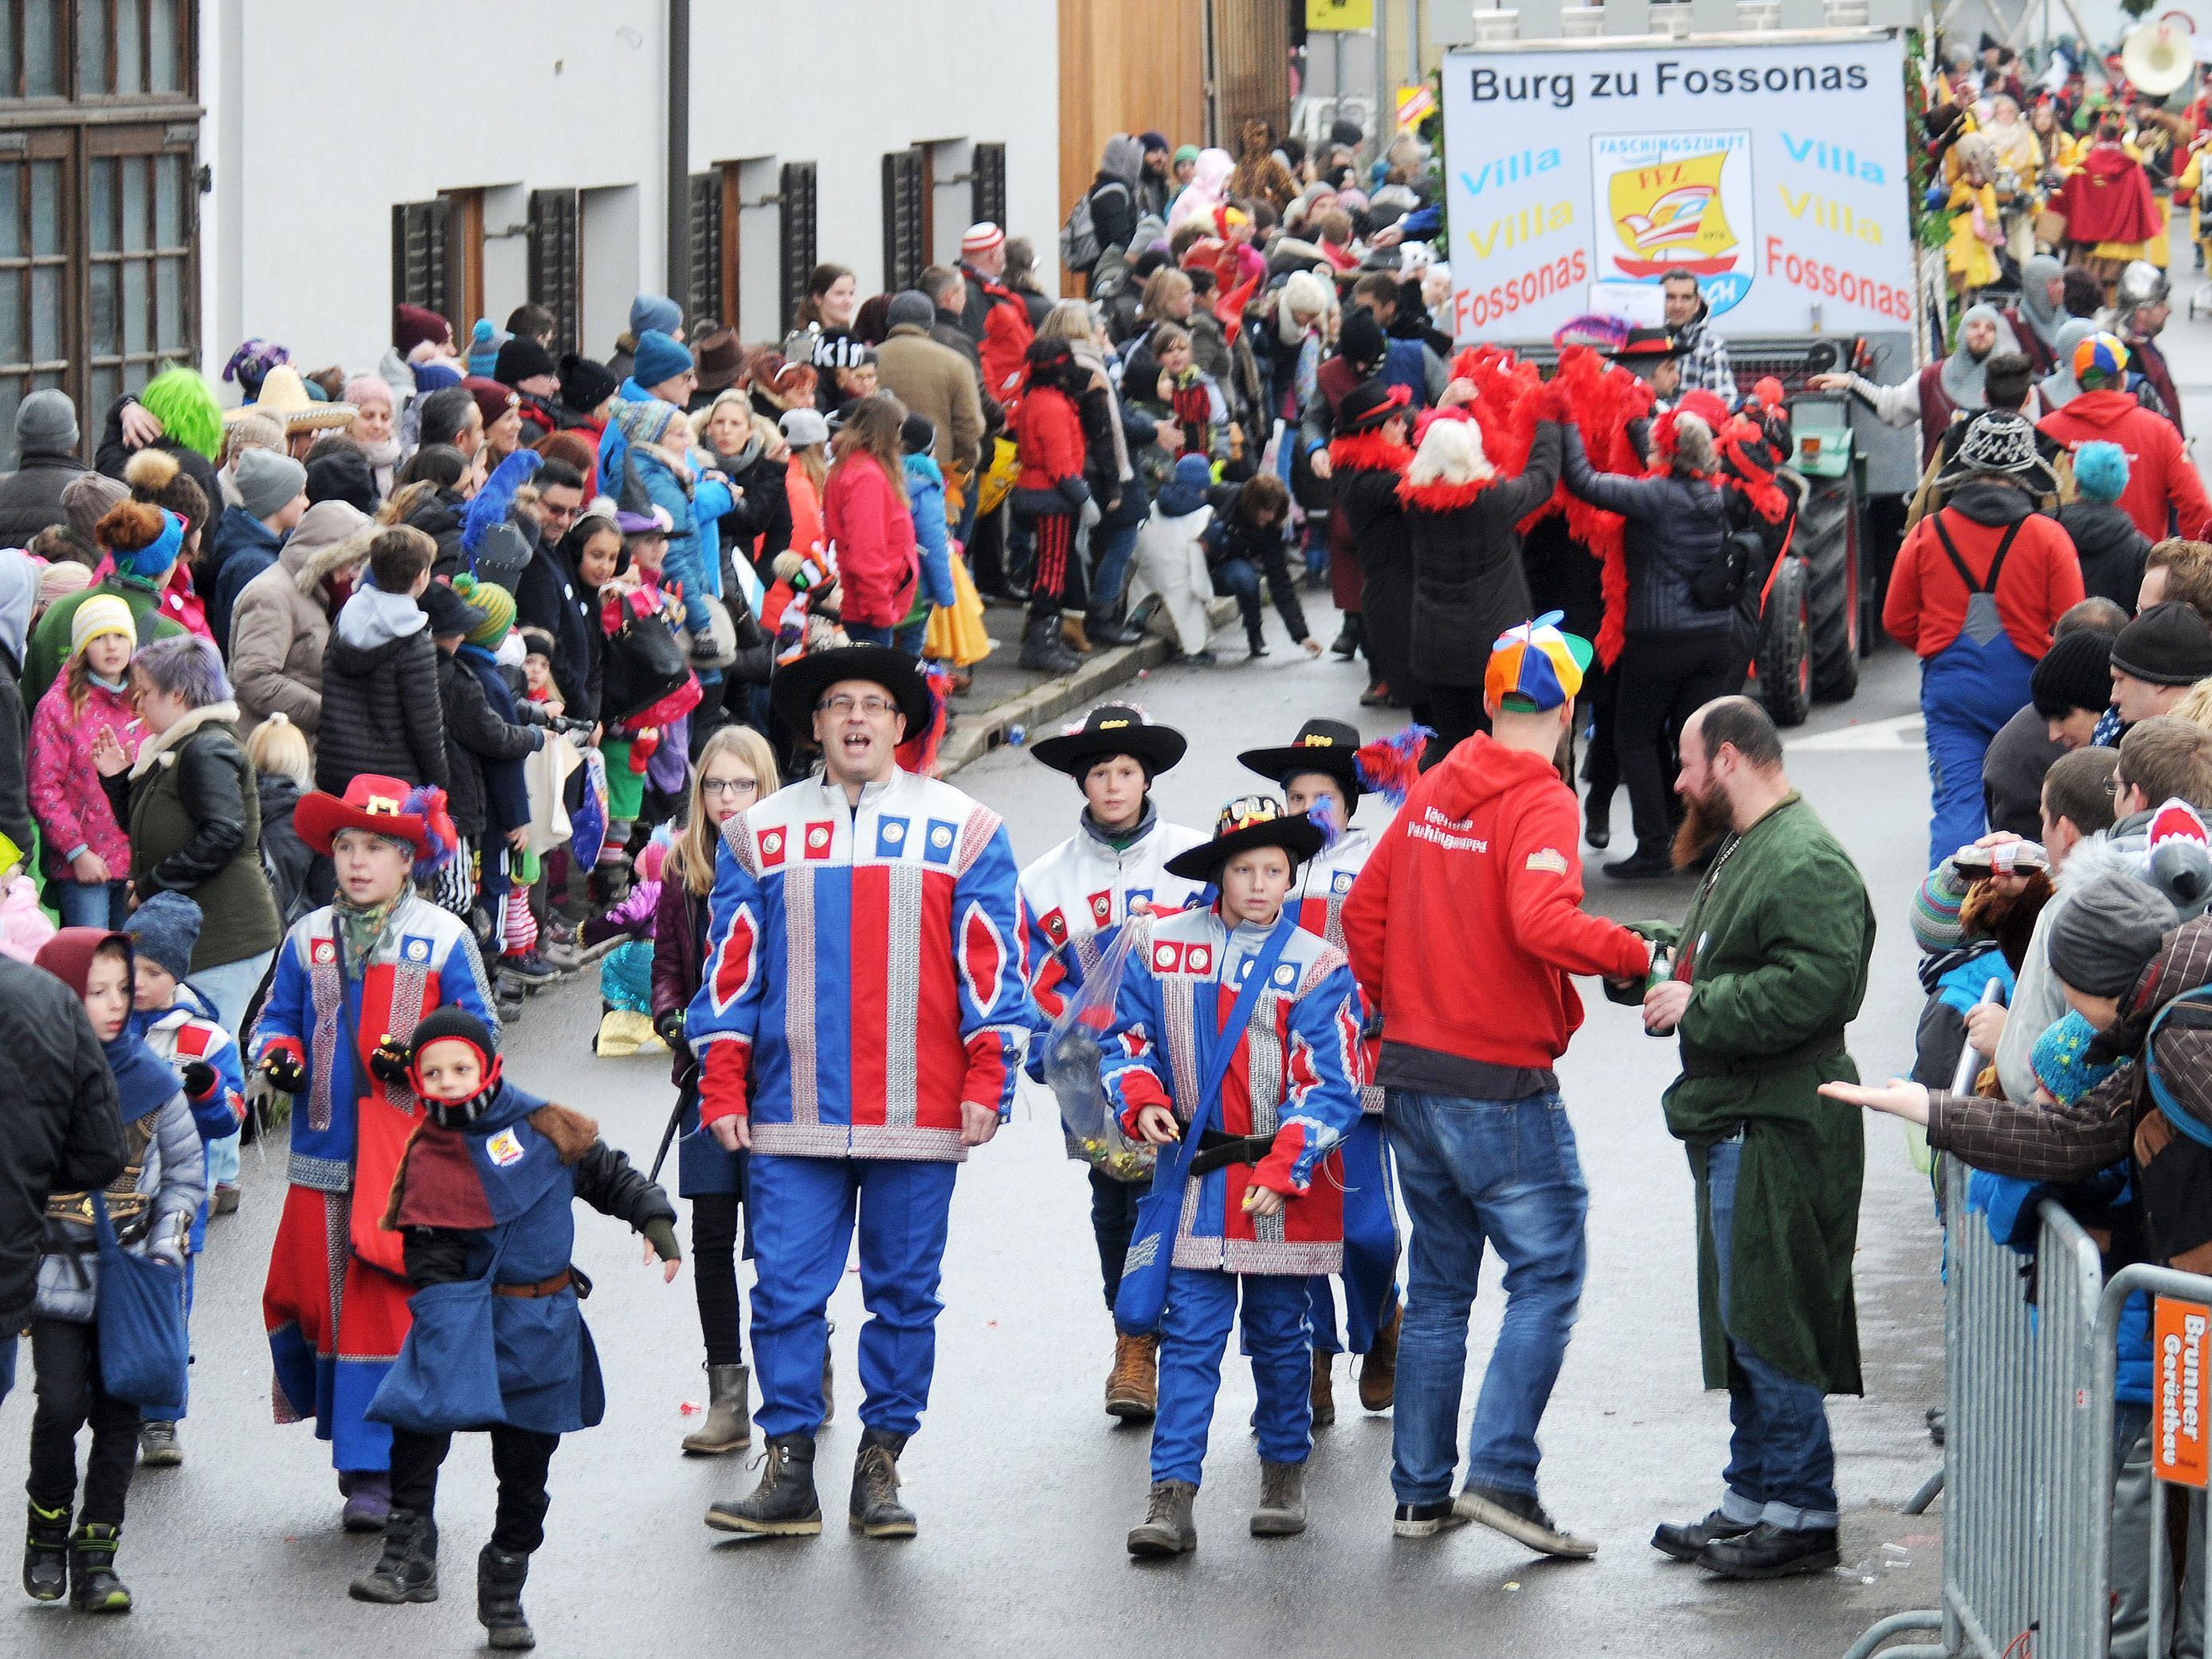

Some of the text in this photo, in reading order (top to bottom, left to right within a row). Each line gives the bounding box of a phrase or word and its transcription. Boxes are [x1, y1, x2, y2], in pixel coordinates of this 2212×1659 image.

[1471, 61, 1869, 108] Burg zu Fossonas
[1461, 147, 1562, 195] Villa
[1599, 135, 1745, 154] FASCHINGSZUNFT
[1780, 131, 1887, 186] Villa
[1467, 199, 1574, 260] Villa
[1779, 184, 1883, 245] Villa
[1454, 249, 1588, 335] Fossonas
[1766, 236, 1912, 322] Fossonas
[2163, 1333, 2183, 1466] Gerüstbau
[2183, 1313, 2206, 1442] Brunner
